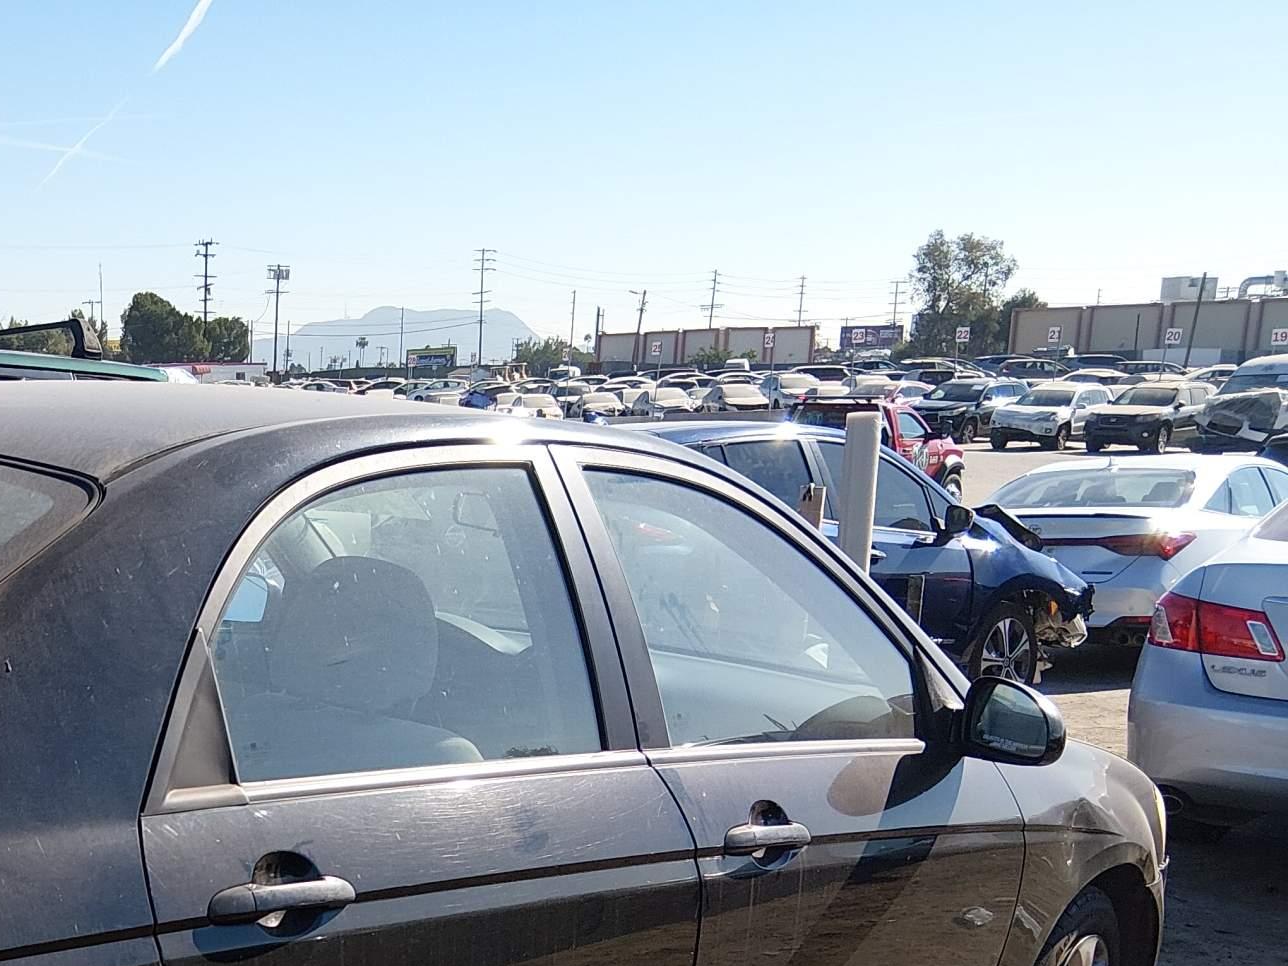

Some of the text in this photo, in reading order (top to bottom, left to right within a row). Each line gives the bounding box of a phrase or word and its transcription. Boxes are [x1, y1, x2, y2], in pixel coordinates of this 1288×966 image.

[853, 331, 864, 341] 23
[957, 330, 969, 340] 22
[1166, 330, 1181, 341] 20
[1272, 331, 1288, 342] 19
[1211, 664, 1267, 678] LEXUS
